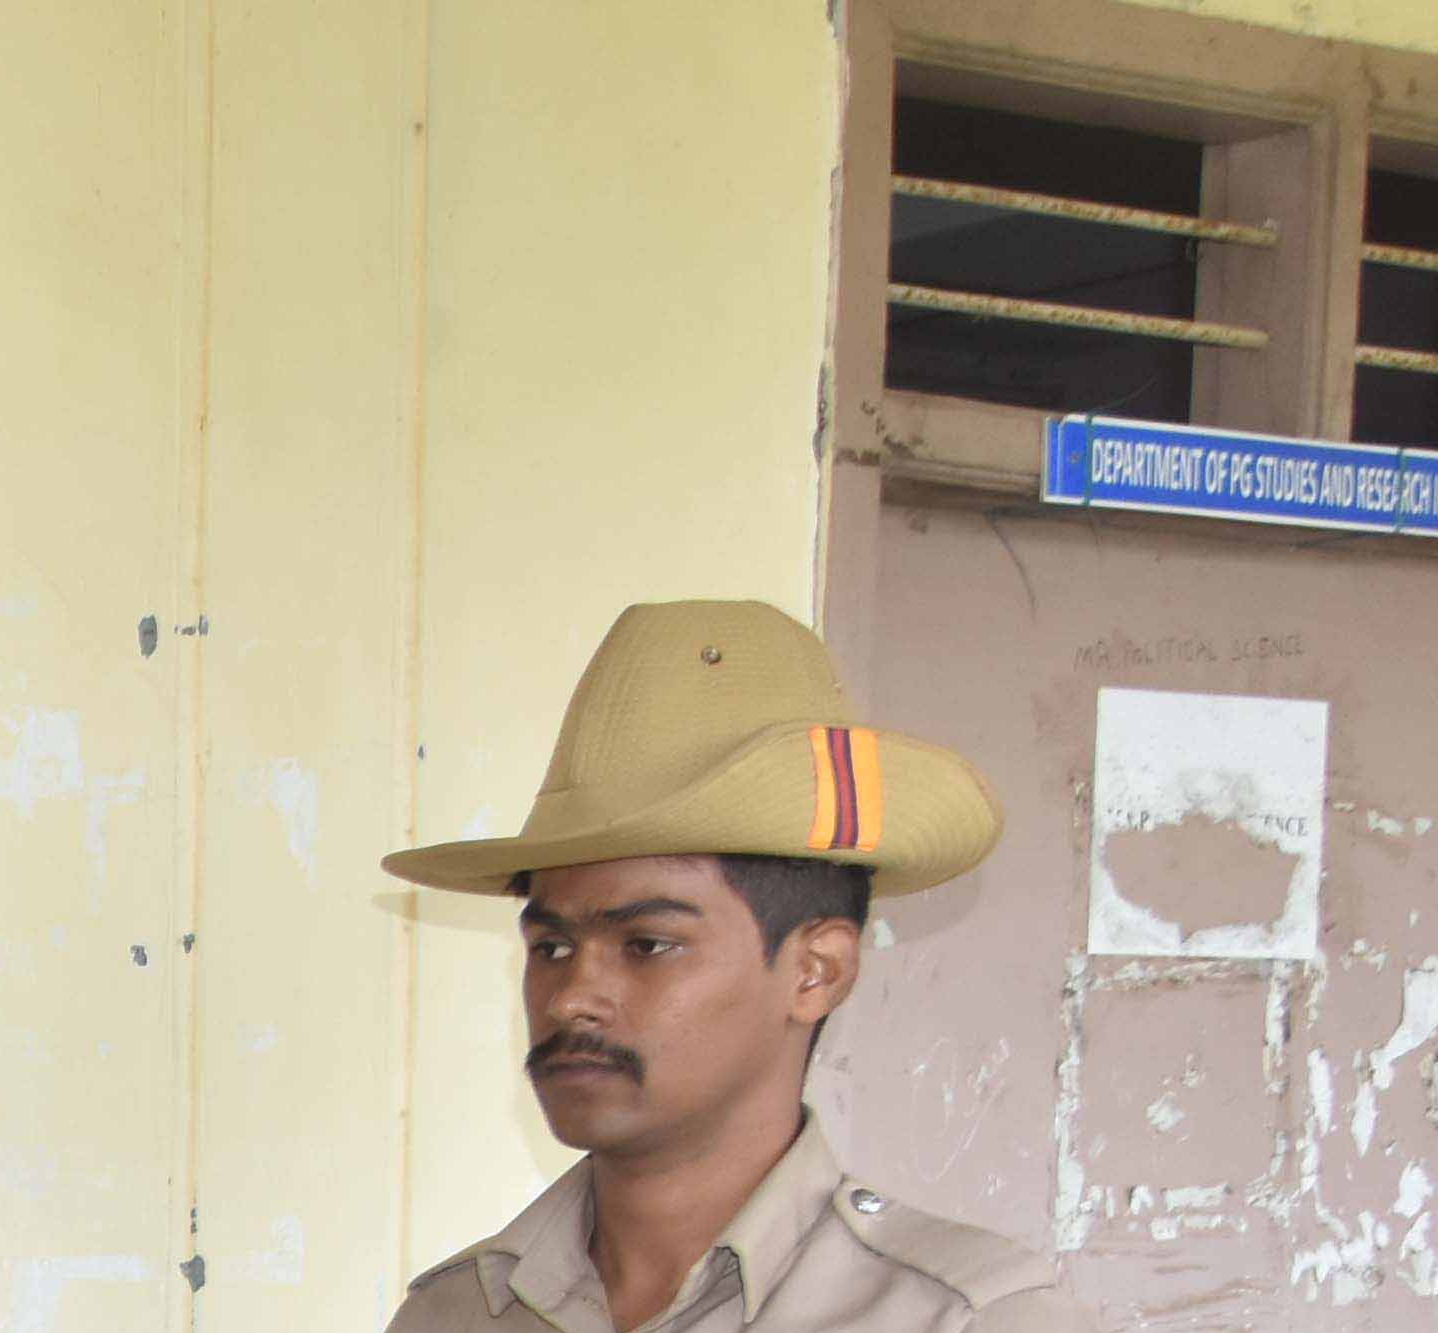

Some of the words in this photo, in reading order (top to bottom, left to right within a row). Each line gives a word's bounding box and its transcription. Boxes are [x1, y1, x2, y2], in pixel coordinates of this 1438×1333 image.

[1091, 438, 1205, 491] DEPARTMENT
[1205, 450, 1227, 494] OF
[1230, 453, 1254, 499] PG
[1256, 455, 1319, 505] STUDIES
[1320, 463, 1353, 508] AND
[1357, 466, 1432, 515] RESEARCH
